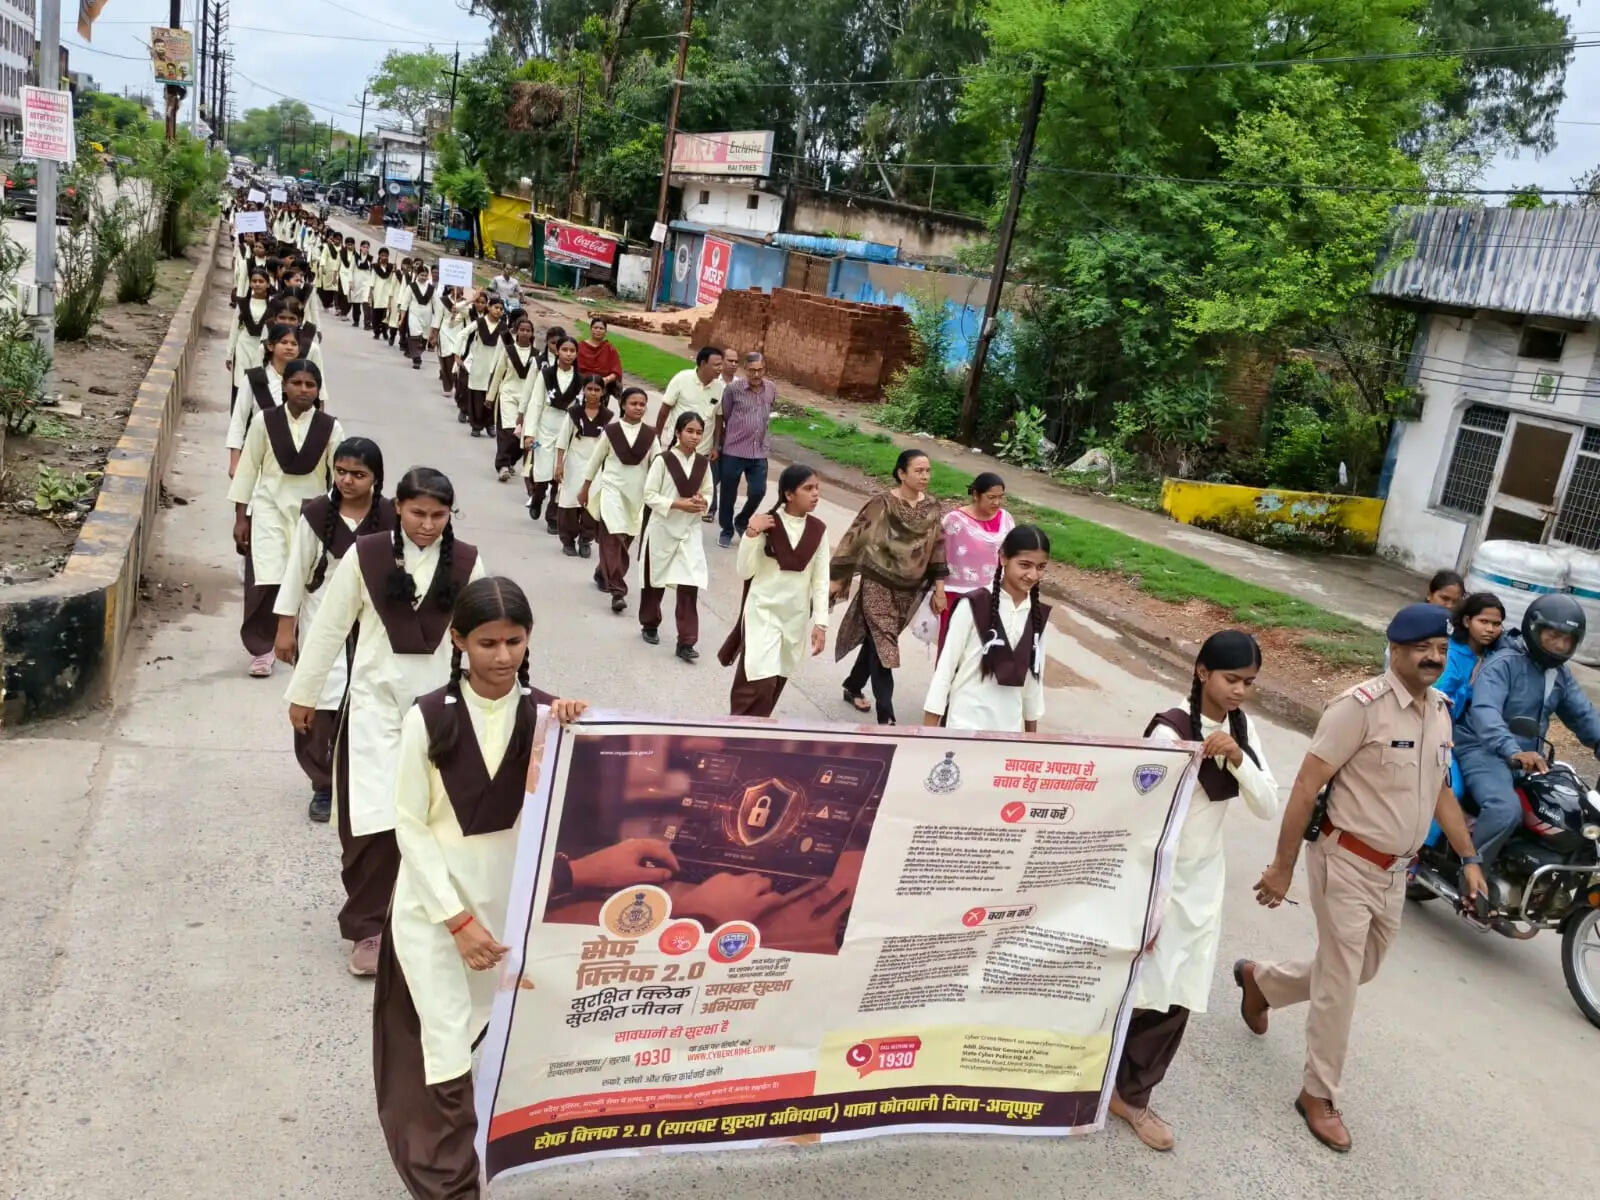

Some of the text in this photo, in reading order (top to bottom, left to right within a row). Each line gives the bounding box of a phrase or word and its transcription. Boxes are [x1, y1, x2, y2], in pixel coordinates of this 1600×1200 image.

[702, 265, 724, 286] MRF
[1005, 759, 1096, 776] सायबर अपराध से
[993, 774, 1099, 792] बचाव हेतु सावधानियां
[1030, 806, 1068, 820] क्या करें
[988, 906, 1033, 920] क्या न करें
[581, 935, 639, 961] सेफ
[576, 960, 706, 990] क्लिक 2.0
[705, 979, 794, 997] सायबर सुरक्षा
[571, 985, 693, 1012] सुरक्षित क्लिक
[700, 997, 759, 1014] अभियान
[566, 1001, 684, 1028] सुरक्षित जीवन
[614, 1020, 730, 1043] सावधानी ही सुरक्षा है
[634, 1048, 671, 1067] 1930
[879, 1052, 913, 1068] 1930
[534, 1131, 569, 1150] सेफ
[570, 1125, 620, 1144] क्लिक
[622, 1123, 652, 1138] 2.0
[656, 1117, 719, 1139] (सायबर
[720, 1113, 768, 1135] सुरक्षा
[769, 1102, 840, 1126] अभियान)
[843, 1101, 878, 1118] थाना
[879, 1093, 940, 1115] कोतवाली
